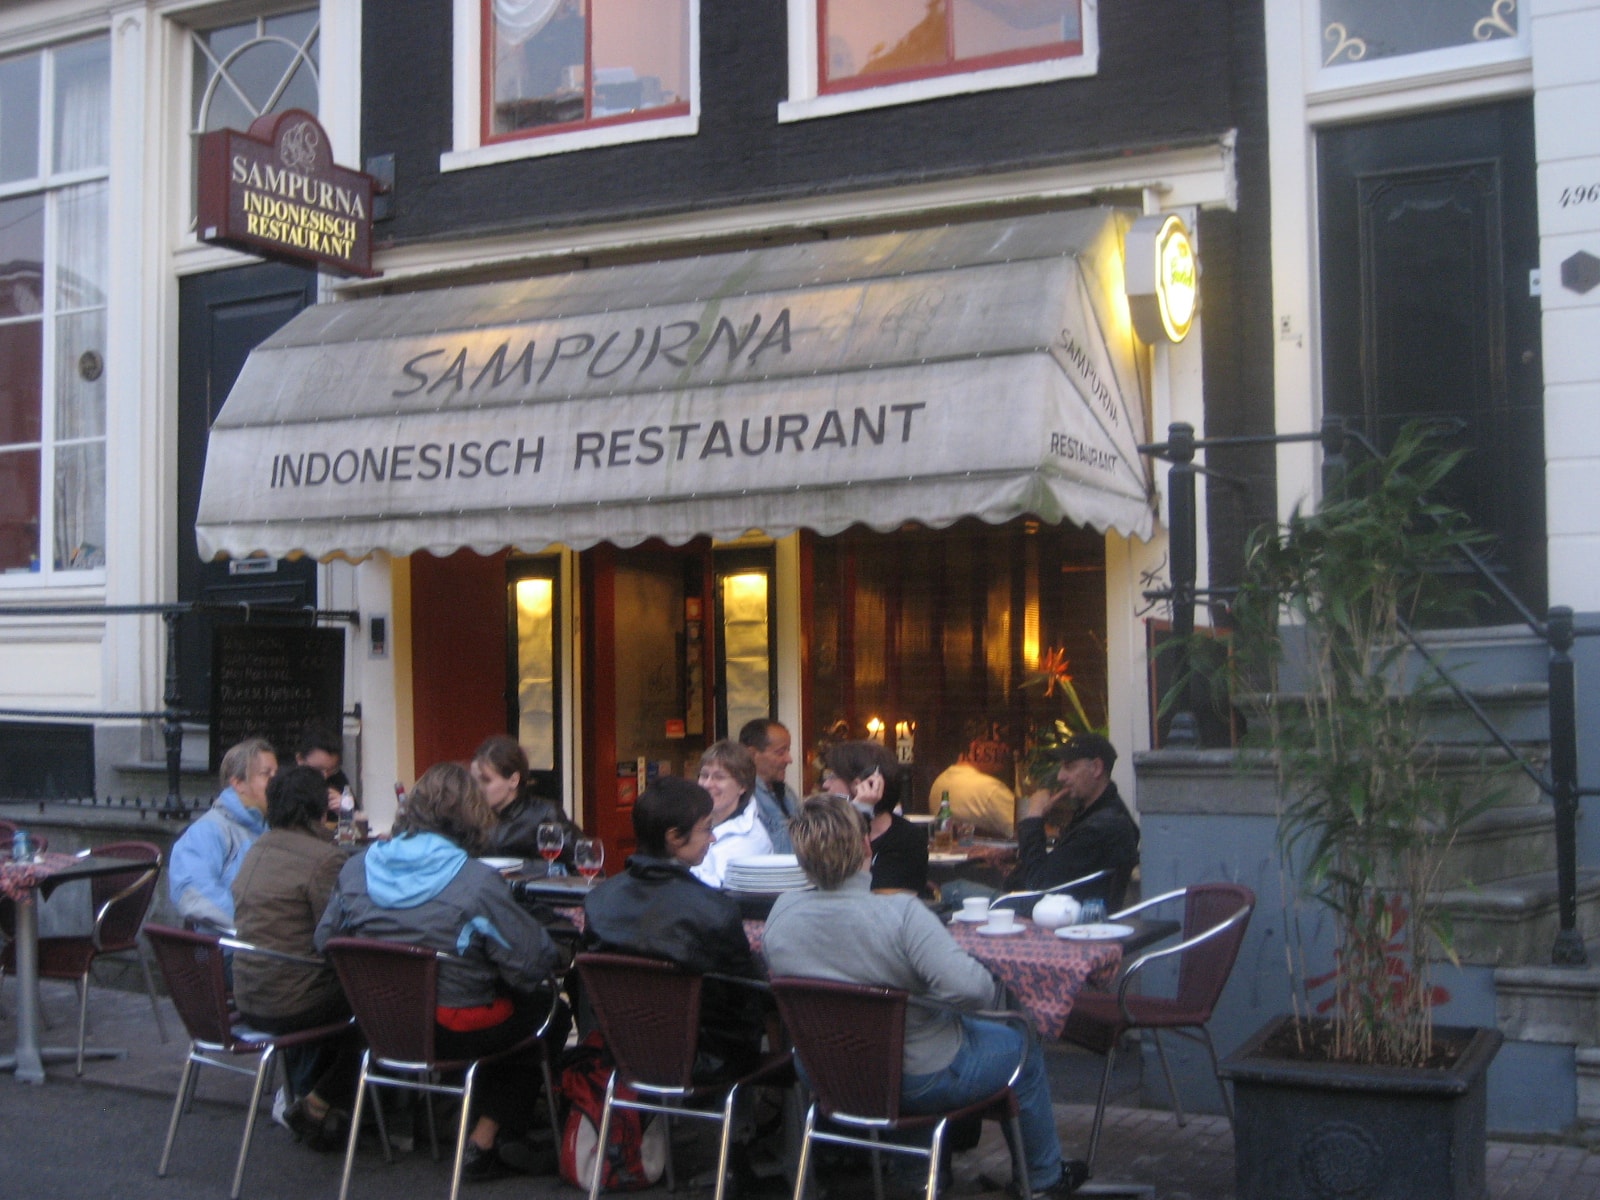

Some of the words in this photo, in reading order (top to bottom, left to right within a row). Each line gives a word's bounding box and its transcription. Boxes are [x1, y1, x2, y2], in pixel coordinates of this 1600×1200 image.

[232, 155, 366, 220] SAMPURNA
[243, 190, 357, 241] INDONESISCH
[1559, 183, 1600, 208] 496
[247, 213, 353, 260] RESTAURANT
[393, 307, 791, 398] SAMPURNA
[1059, 328, 1119, 428] SAMPURNA
[271, 436, 545, 488] INDONESISCH
[575, 402, 926, 470] RESTAURANT
[1051, 432, 1118, 475] RESTAURANT
